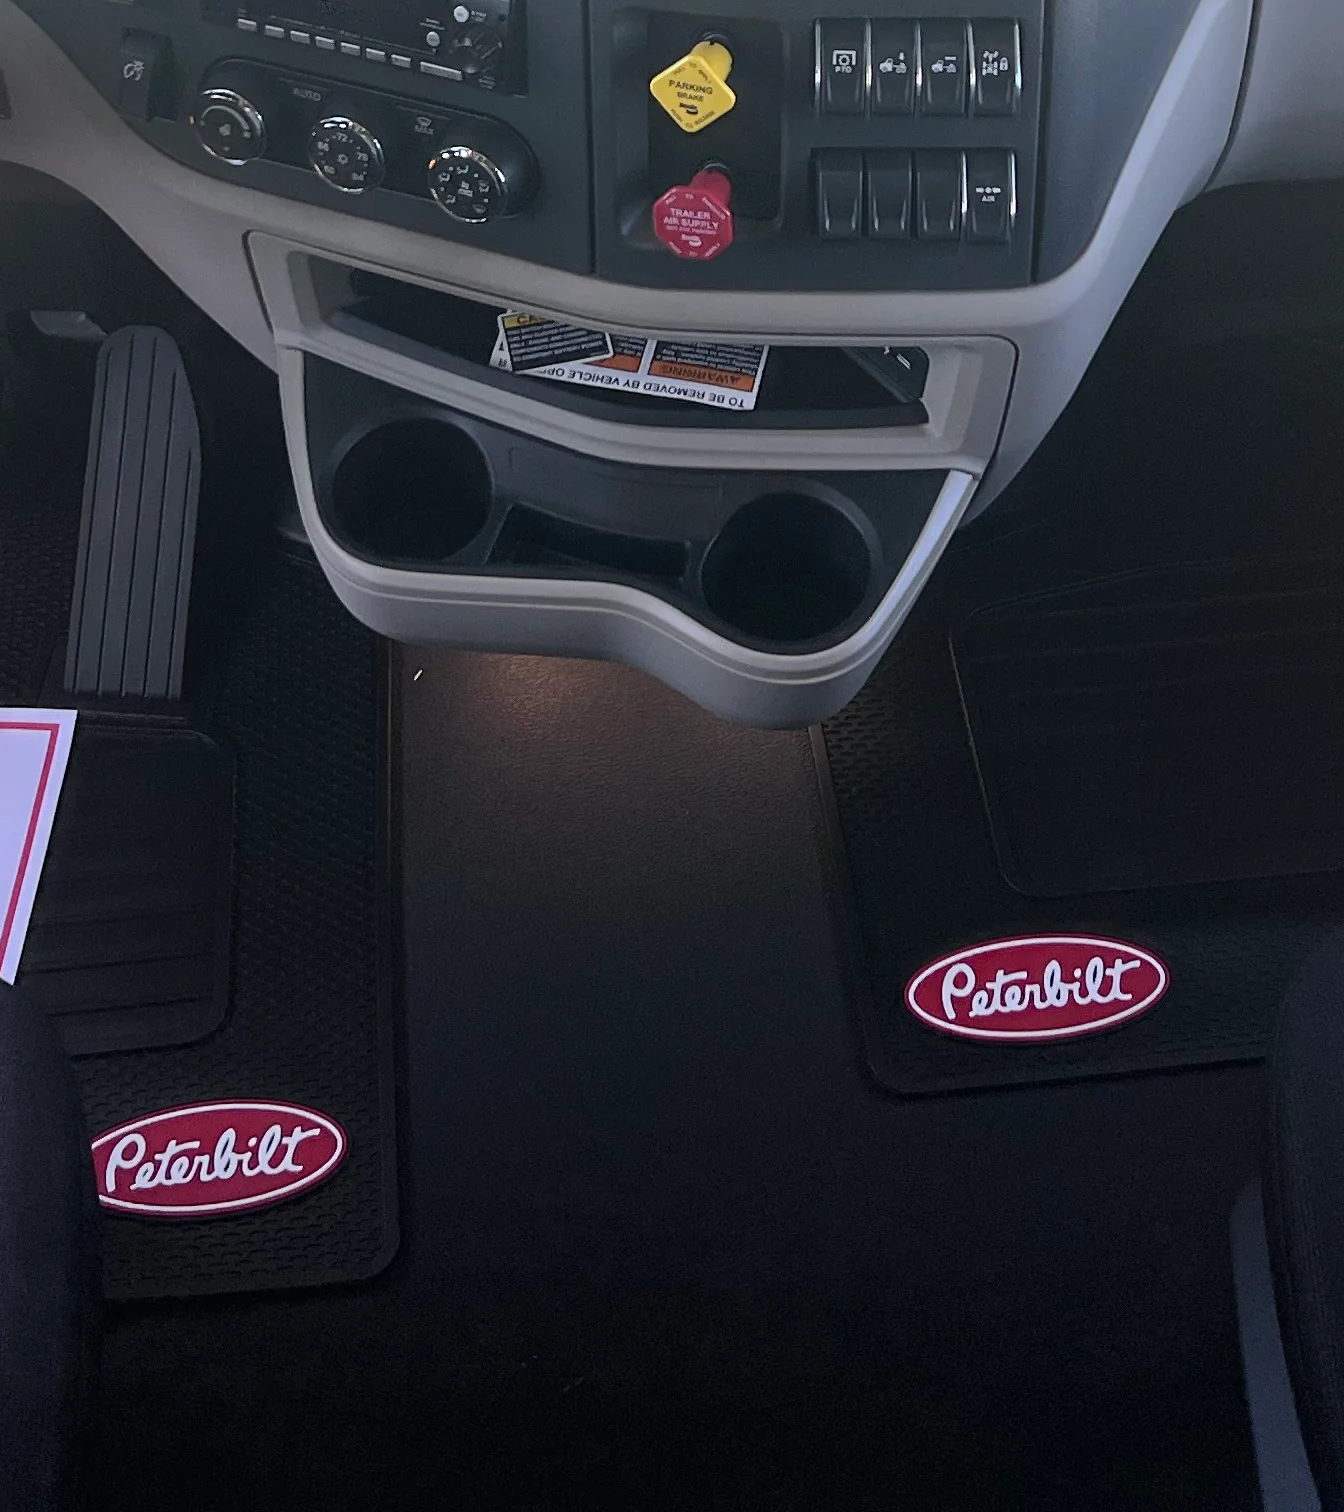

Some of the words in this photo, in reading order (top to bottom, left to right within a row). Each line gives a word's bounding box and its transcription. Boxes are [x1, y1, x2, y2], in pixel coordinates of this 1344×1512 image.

[835, 65, 853, 74] PTO
[668, 79, 714, 95] PARKING
[677, 91, 705, 103] BRAKE
[981, 195, 995, 203] AIR
[670, 207, 711, 220] TRAILER
[663, 216, 679, 225] AIR
[681, 218, 720, 230] SUPPLY
[567, 370, 621, 387] VEHICLE
[623, 377, 641, 390] BY
[644, 380, 704, 401] REMOVED
[709, 392, 725, 406] BE
[729, 396, 745, 409] TO
[941, 956, 1142, 1020] Peterbilt
[105, 1123, 321, 1193] Peterbilt
